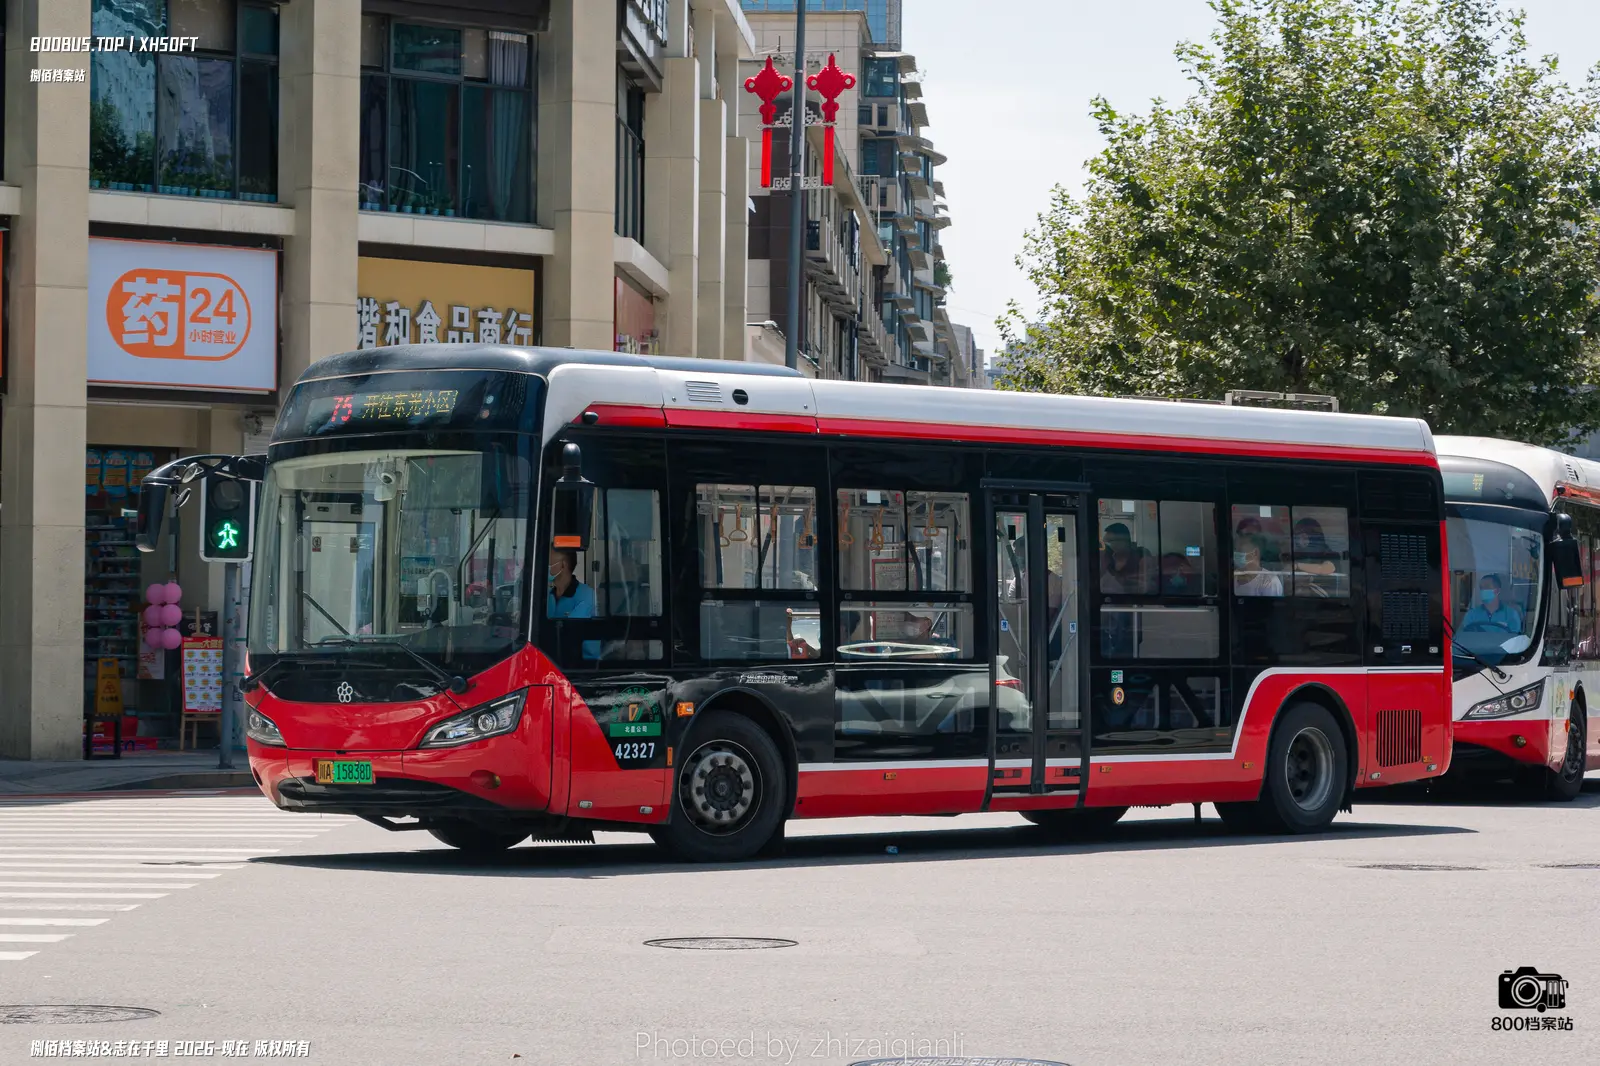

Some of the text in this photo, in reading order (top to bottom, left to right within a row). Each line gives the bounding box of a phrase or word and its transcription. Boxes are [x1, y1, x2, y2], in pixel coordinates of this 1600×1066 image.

[121, 277, 181, 347] 药
[189, 287, 237, 325] 24
[188, 329, 237, 345] 小时营业
[331, 395, 353, 422] 75
[615, 742, 655, 759] 42327
